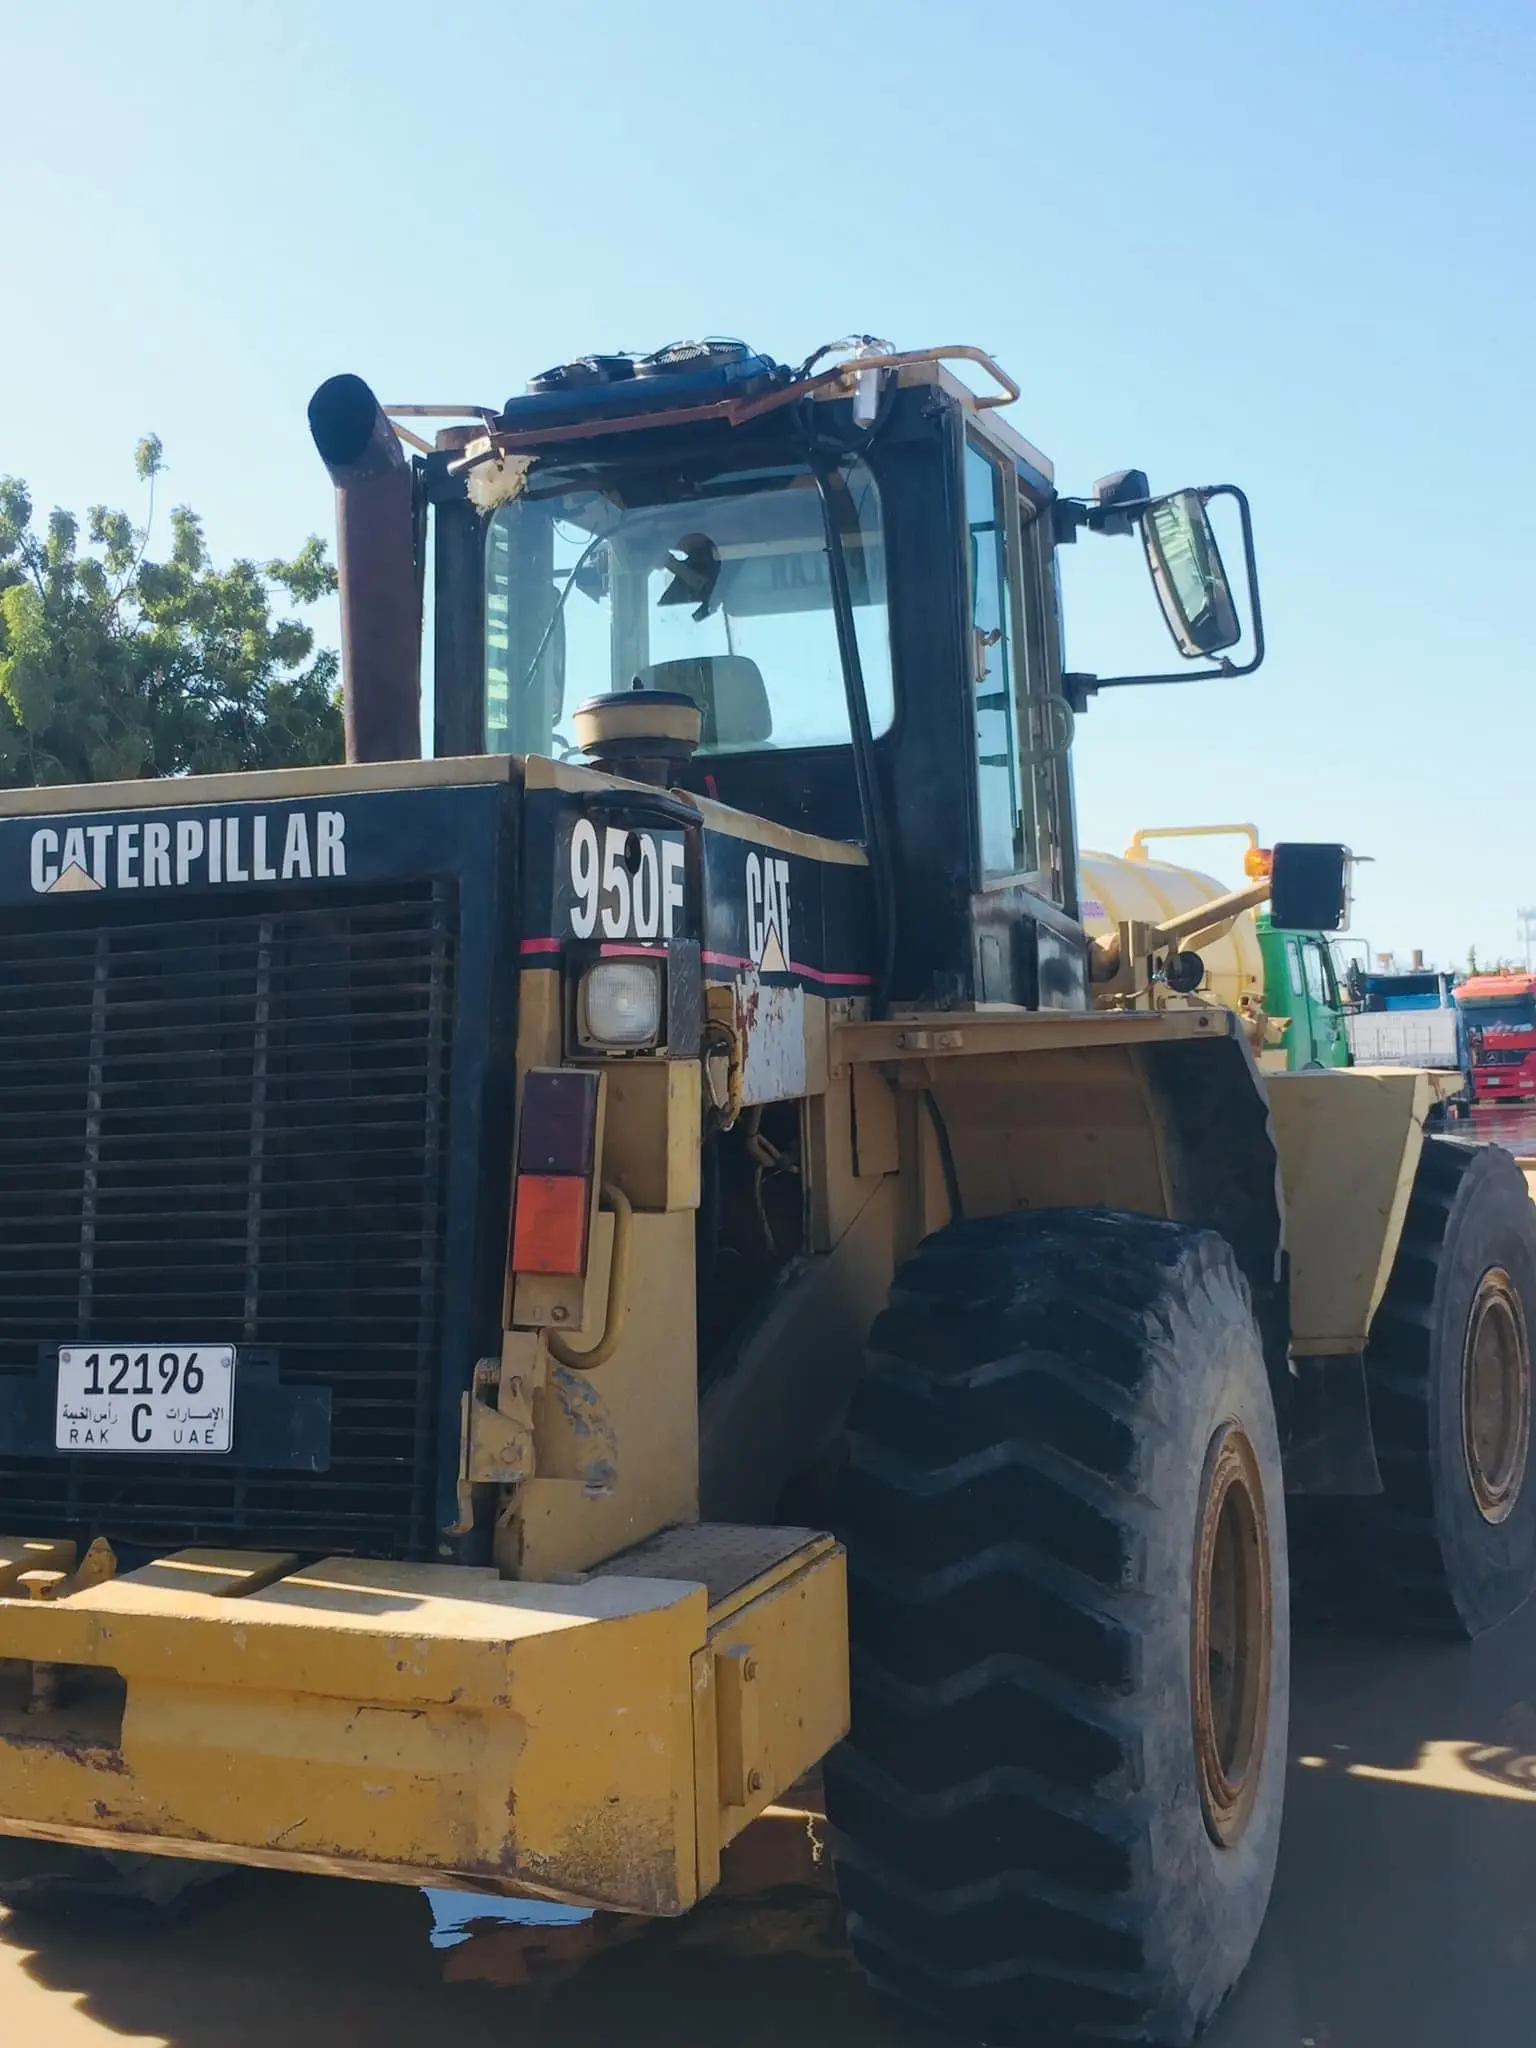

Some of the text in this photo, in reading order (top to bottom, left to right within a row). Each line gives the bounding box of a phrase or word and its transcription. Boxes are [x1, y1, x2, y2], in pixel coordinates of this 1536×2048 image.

[30, 811, 347, 893] CATERPILLAR
[570, 818, 685, 946] 950F
[746, 851, 791, 972] CAT
[84, 1352, 204, 1395] 12196
[93, 1401, 118, 1424] رأس
[132, 1403, 152, 1442] C
[70, 1428, 109, 1444] RAK
[173, 1429, 214, 1444] UAE
